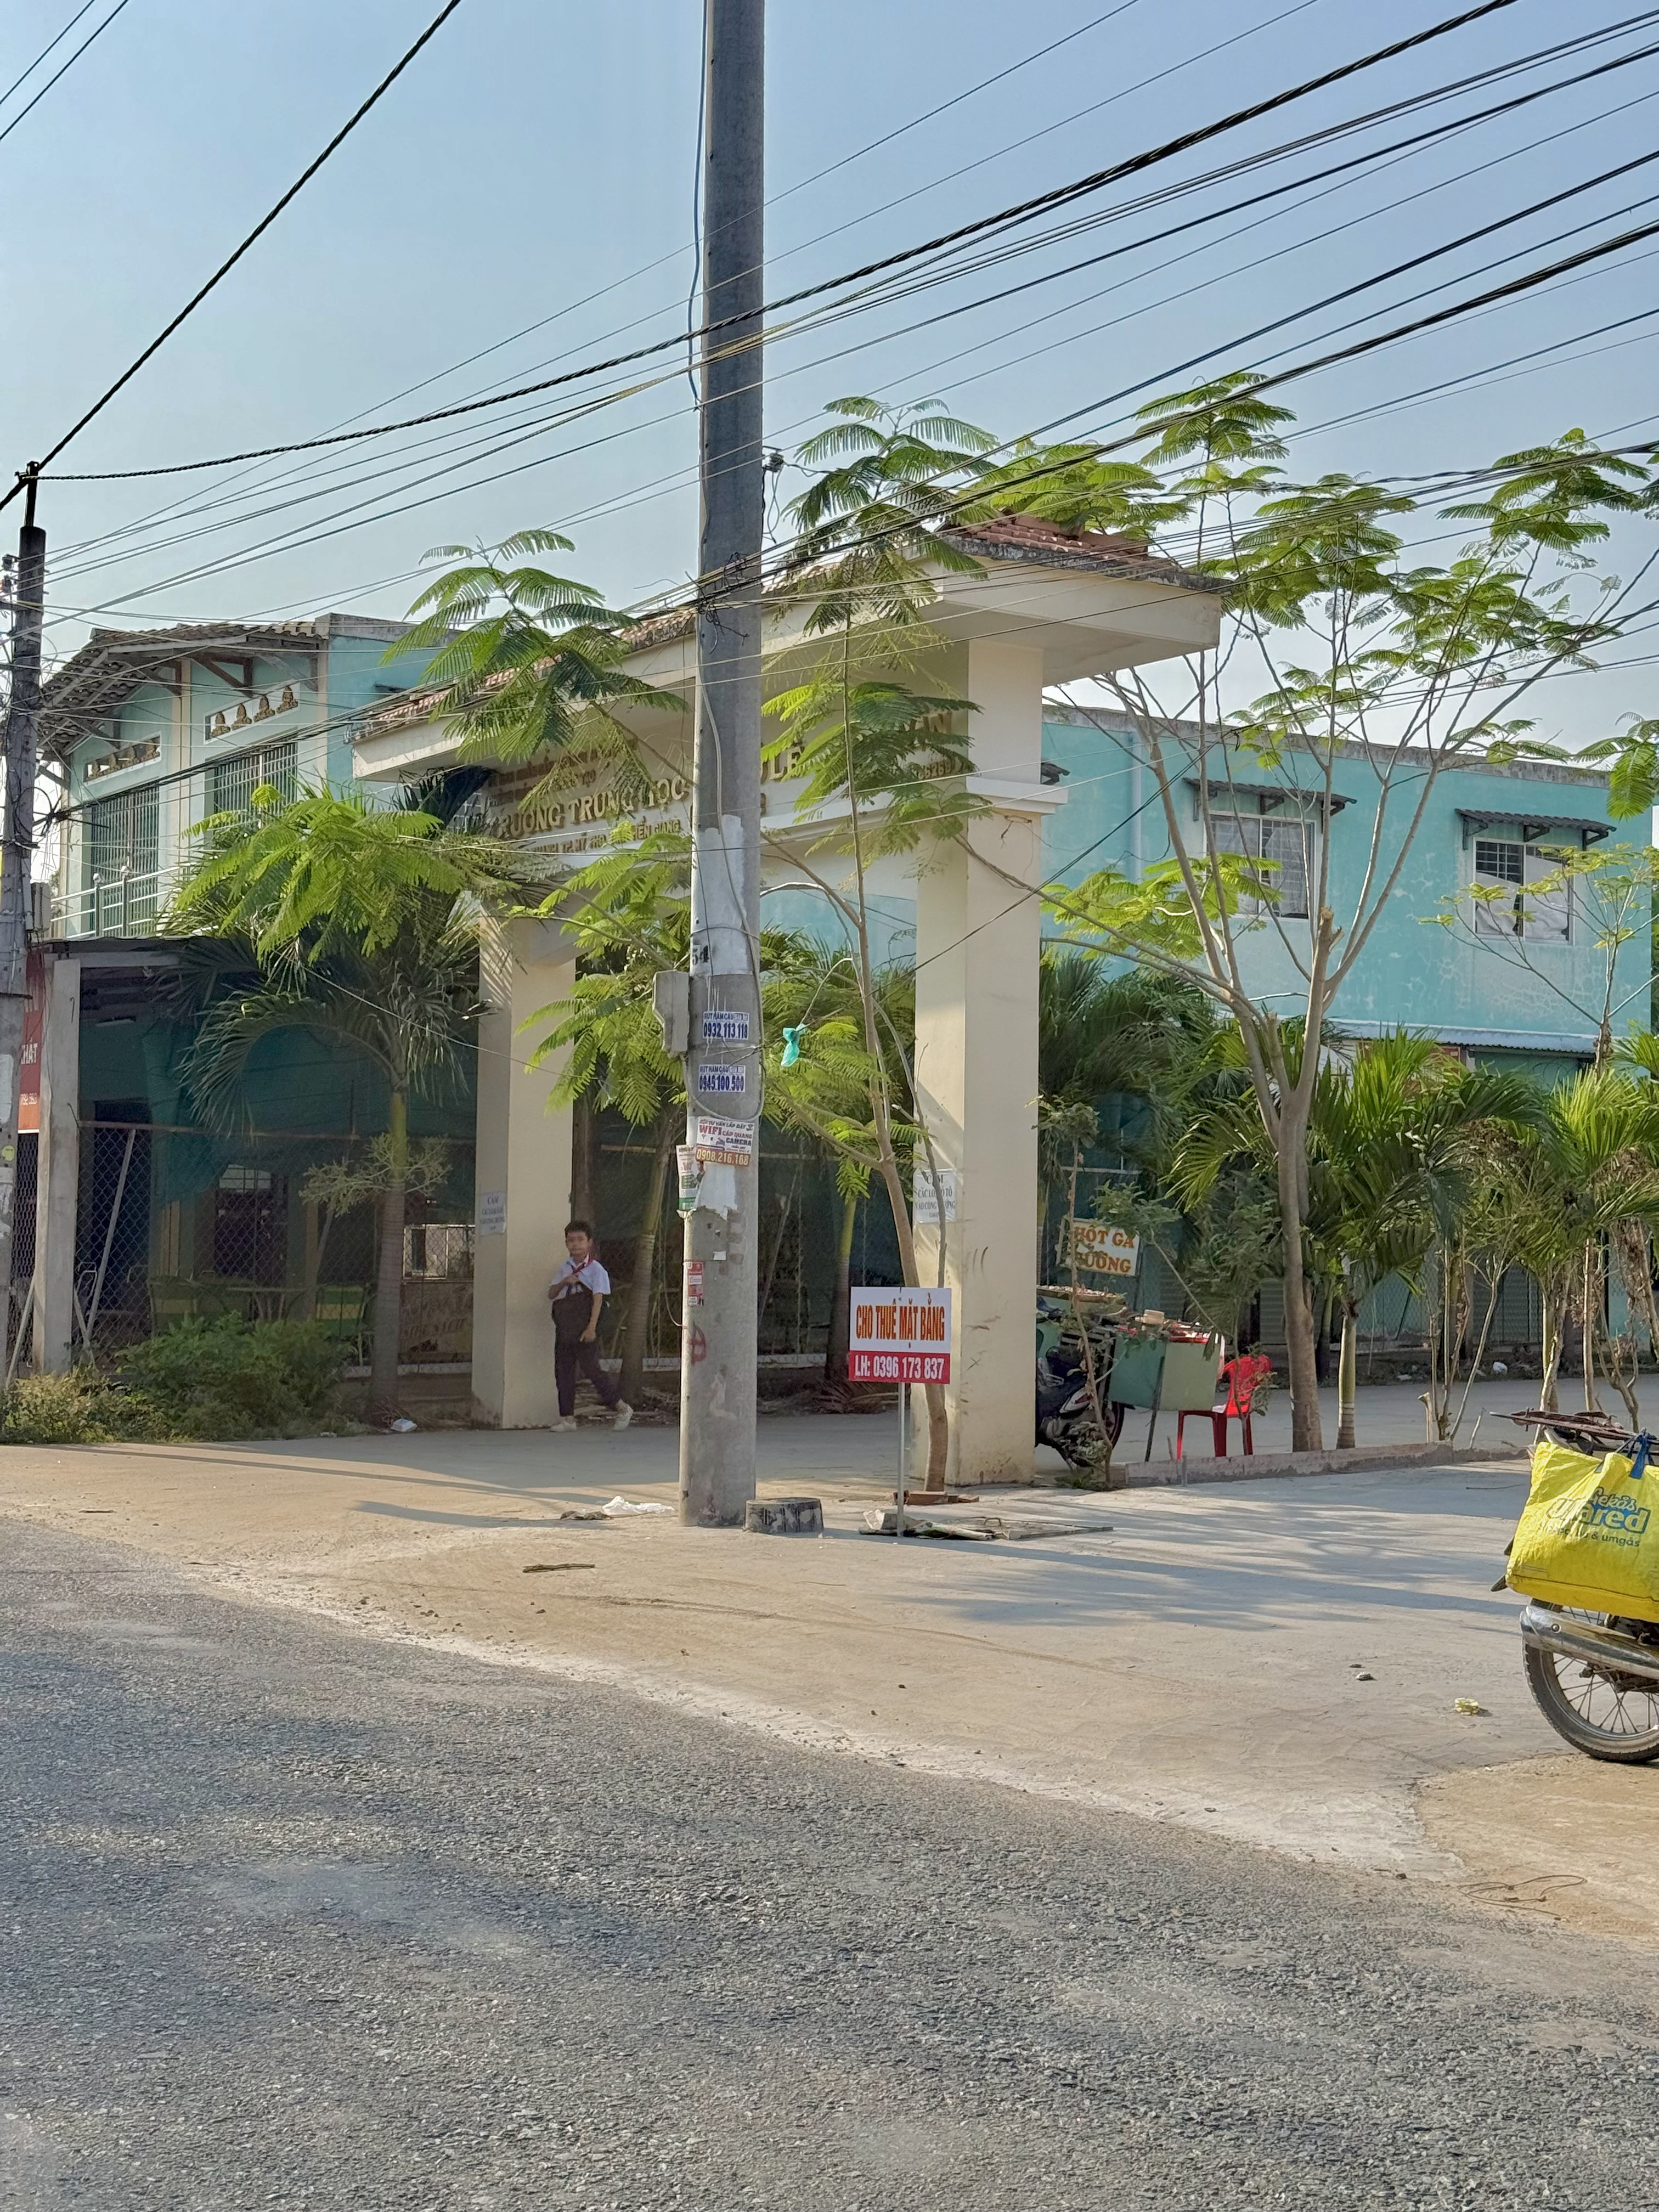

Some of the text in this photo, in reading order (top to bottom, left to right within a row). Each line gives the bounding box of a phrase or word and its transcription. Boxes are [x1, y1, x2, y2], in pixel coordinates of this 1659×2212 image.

[703, 1022, 748, 1039] 0932.113.118
[699, 1125, 723, 1136] WIFI
[726, 1137, 752, 1146] CAMERA
[696, 1149, 749, 1166] 0908.216.168
[856, 1304, 873, 1340] CHO
[876, 1298, 897, 1340] THUÊ
[899, 1298, 918, 1348] MẶT
[855, 1355, 945, 1380] LH: 0396 173 837
[1601, 1534, 1641, 1548] umgås
